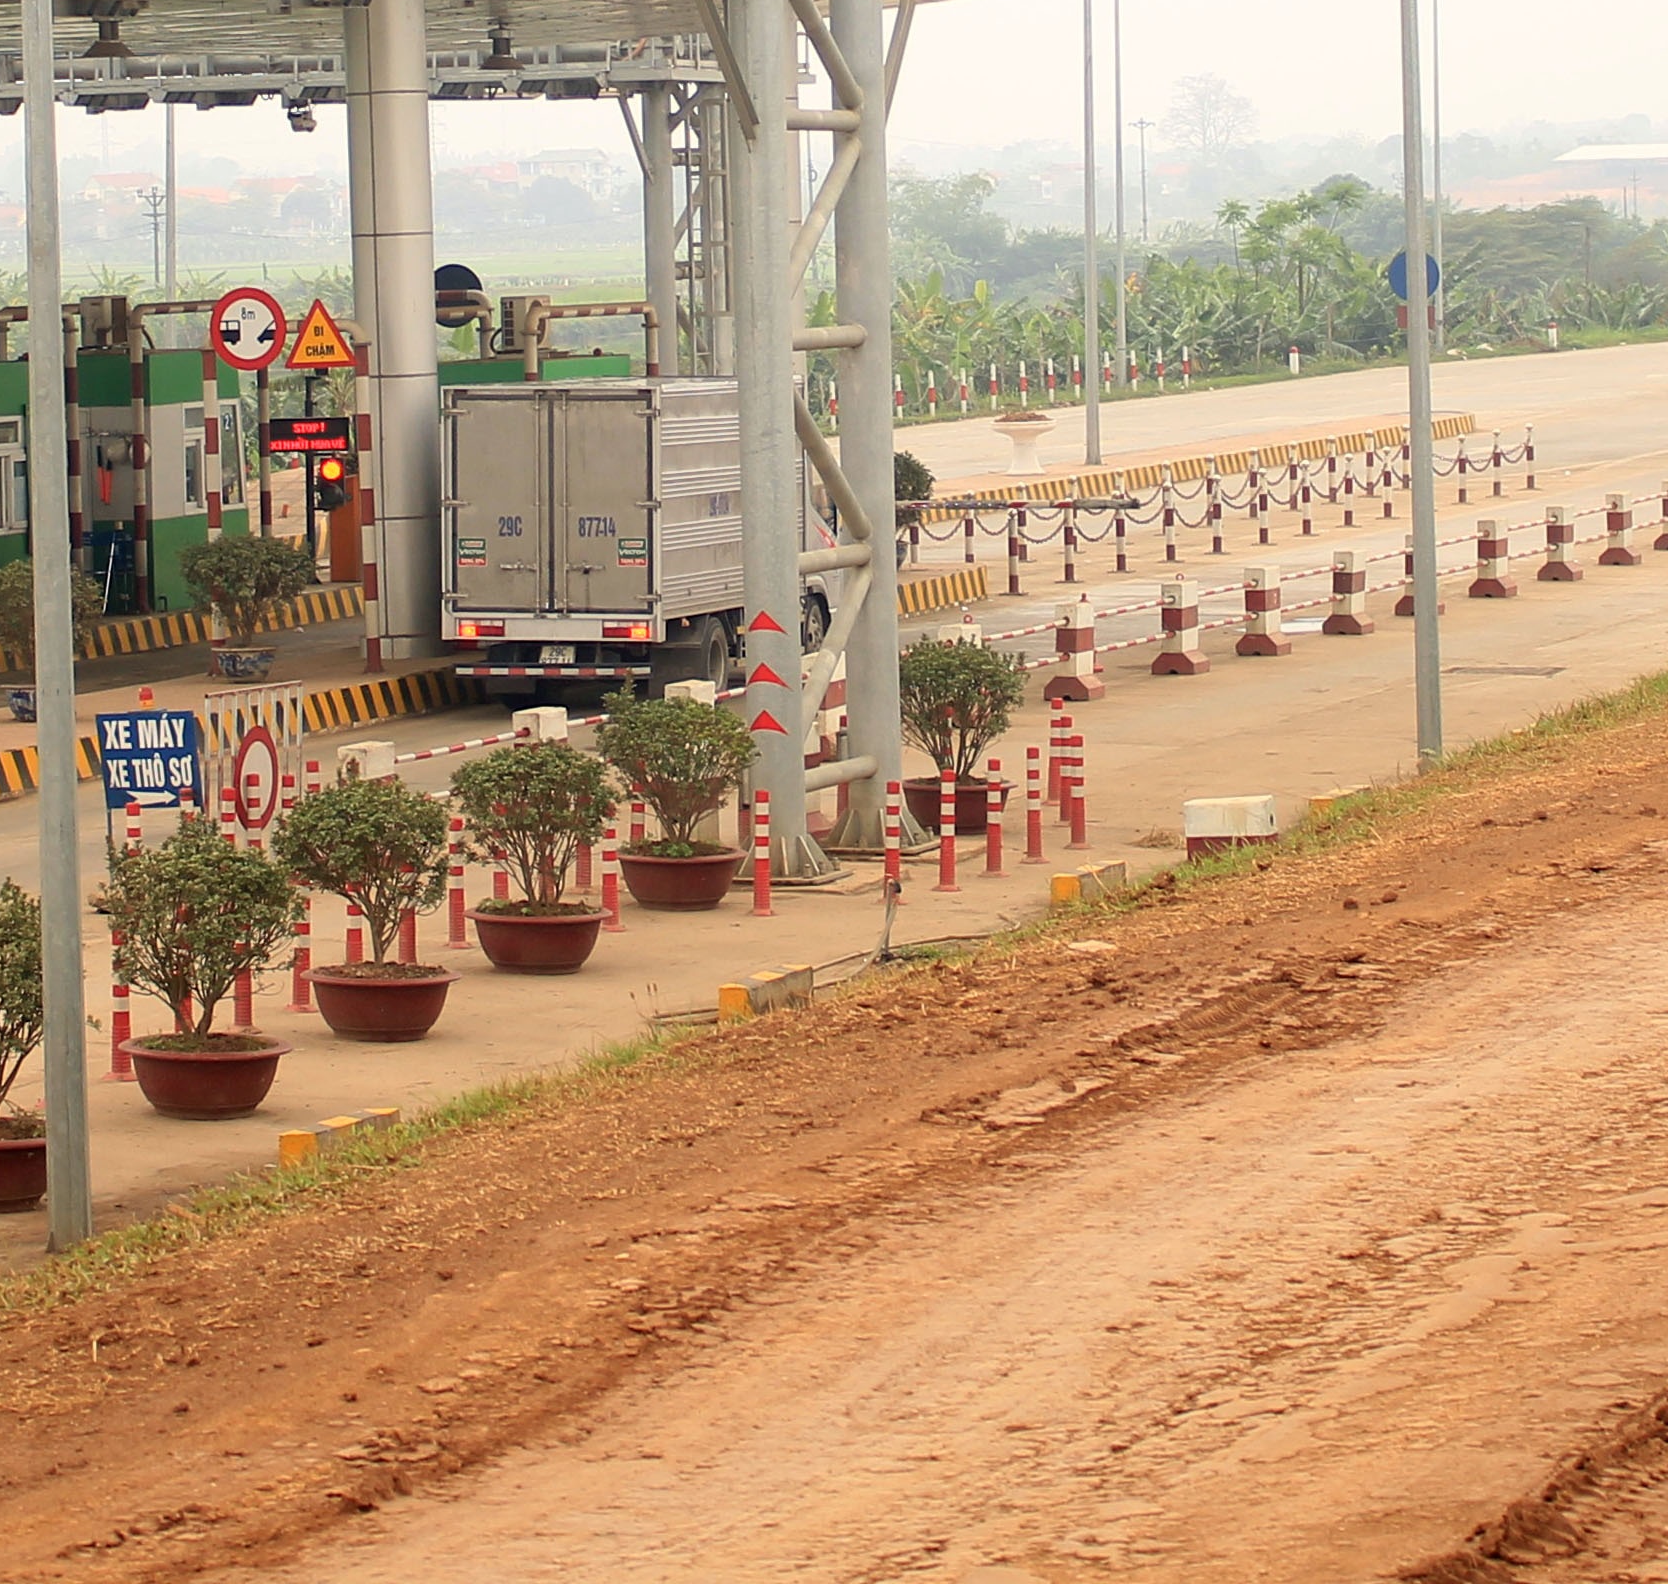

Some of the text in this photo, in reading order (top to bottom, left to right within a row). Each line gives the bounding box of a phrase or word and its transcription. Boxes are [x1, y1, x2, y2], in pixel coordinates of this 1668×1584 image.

[240, 306, 256, 320] 8m
[498, 515, 523, 537] 29C
[102, 712, 186, 750] XE MÁY
[106, 752, 193, 789] XE THÔ SƠ
